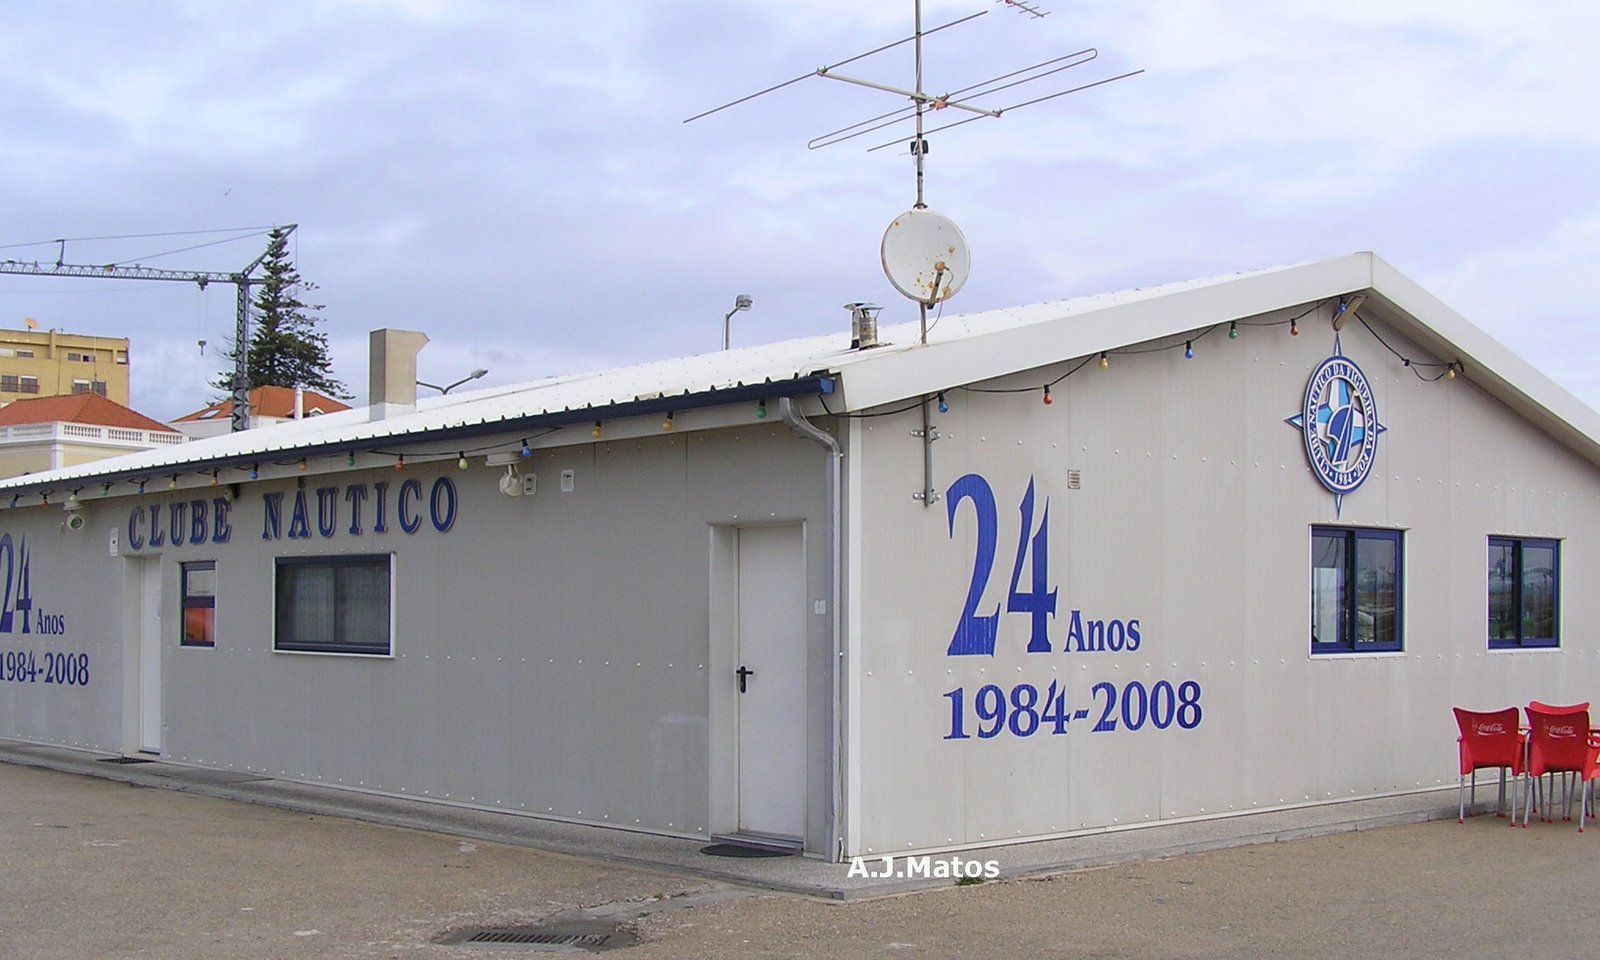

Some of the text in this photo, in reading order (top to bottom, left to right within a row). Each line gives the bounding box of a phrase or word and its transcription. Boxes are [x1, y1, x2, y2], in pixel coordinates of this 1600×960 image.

[1333, 363, 1346, 376] DA
[1333, 471, 1353, 486] 1984
[128, 497, 232, 550] CLUBE
[0, 531, 65, 635] 24 Anos
[946, 473, 1141, 658] 24 Anos
[943, 679, 1203, 740] 1984-2008
